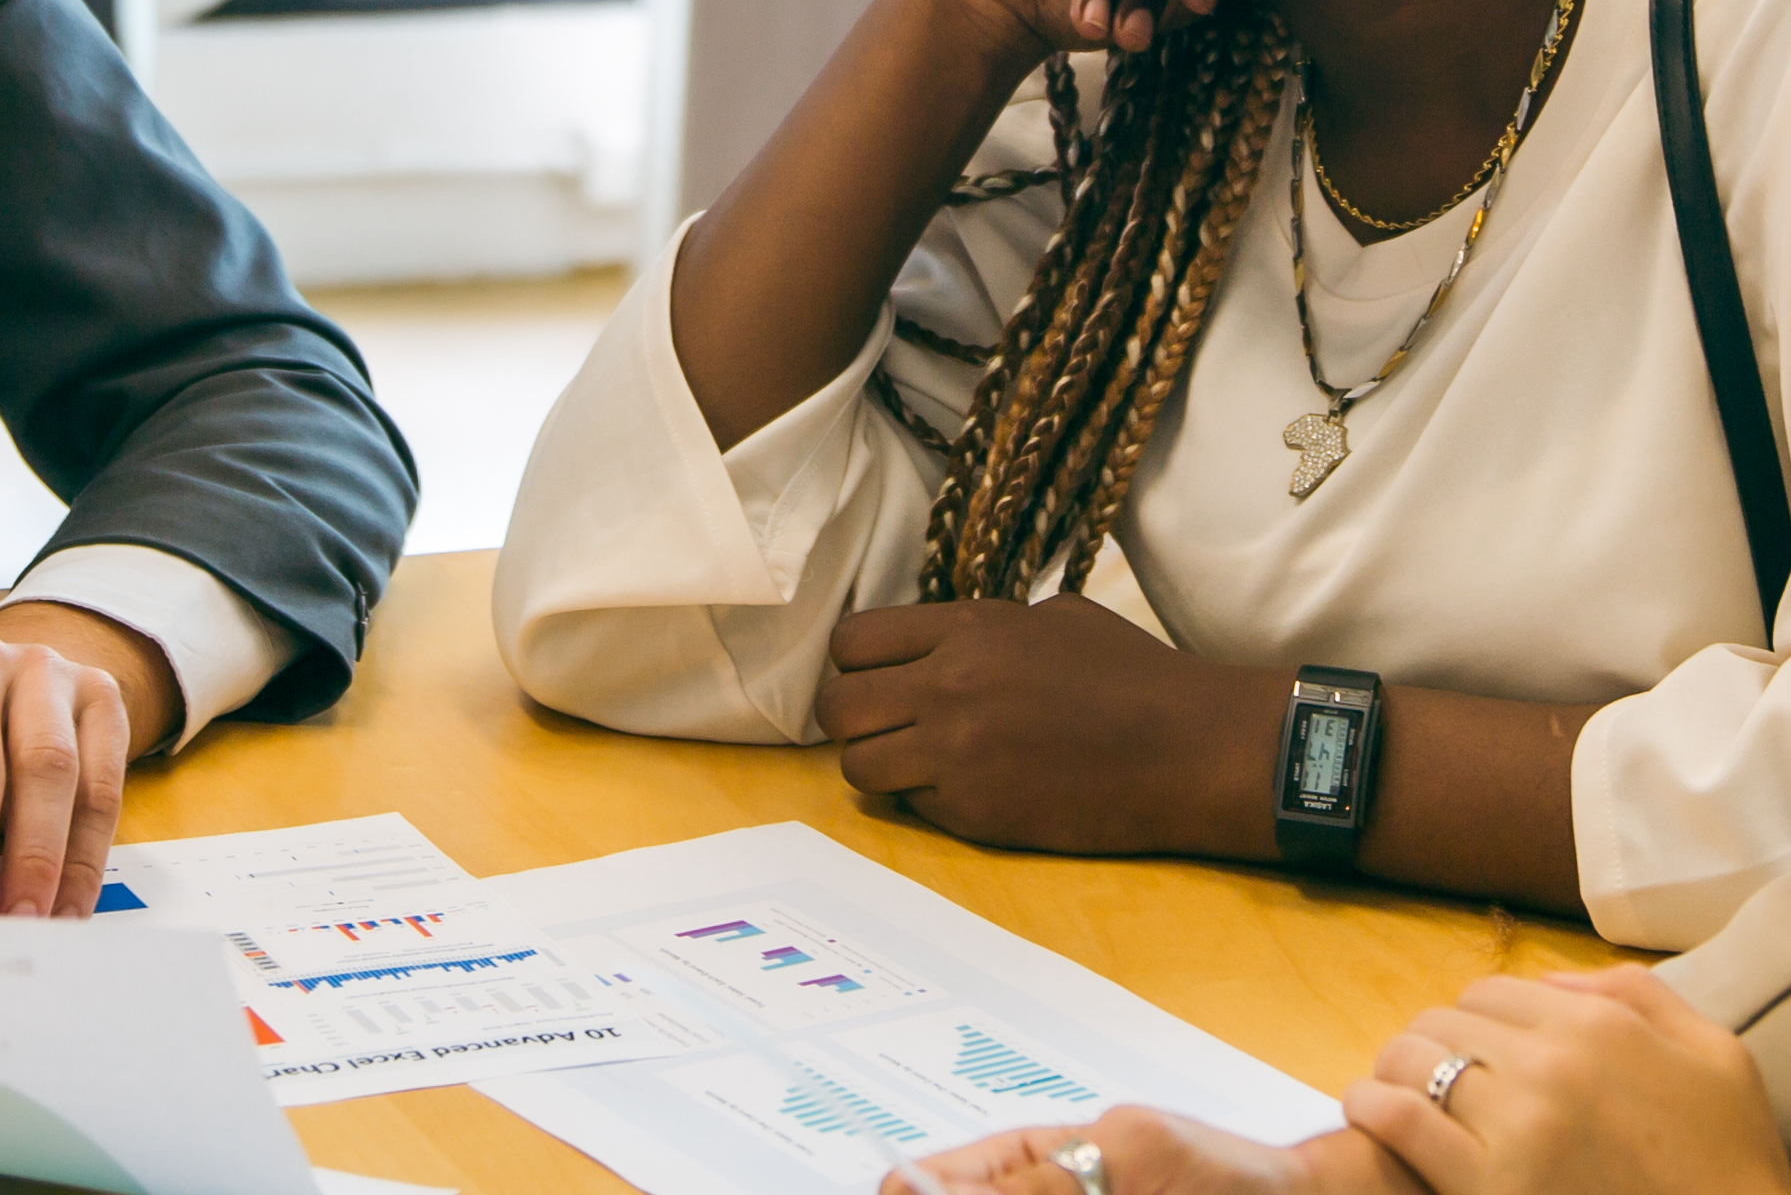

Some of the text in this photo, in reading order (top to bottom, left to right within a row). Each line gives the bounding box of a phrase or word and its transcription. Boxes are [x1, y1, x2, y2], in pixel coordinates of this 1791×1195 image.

[264, 1027, 622, 1081] 10 Advanced Excel Char
